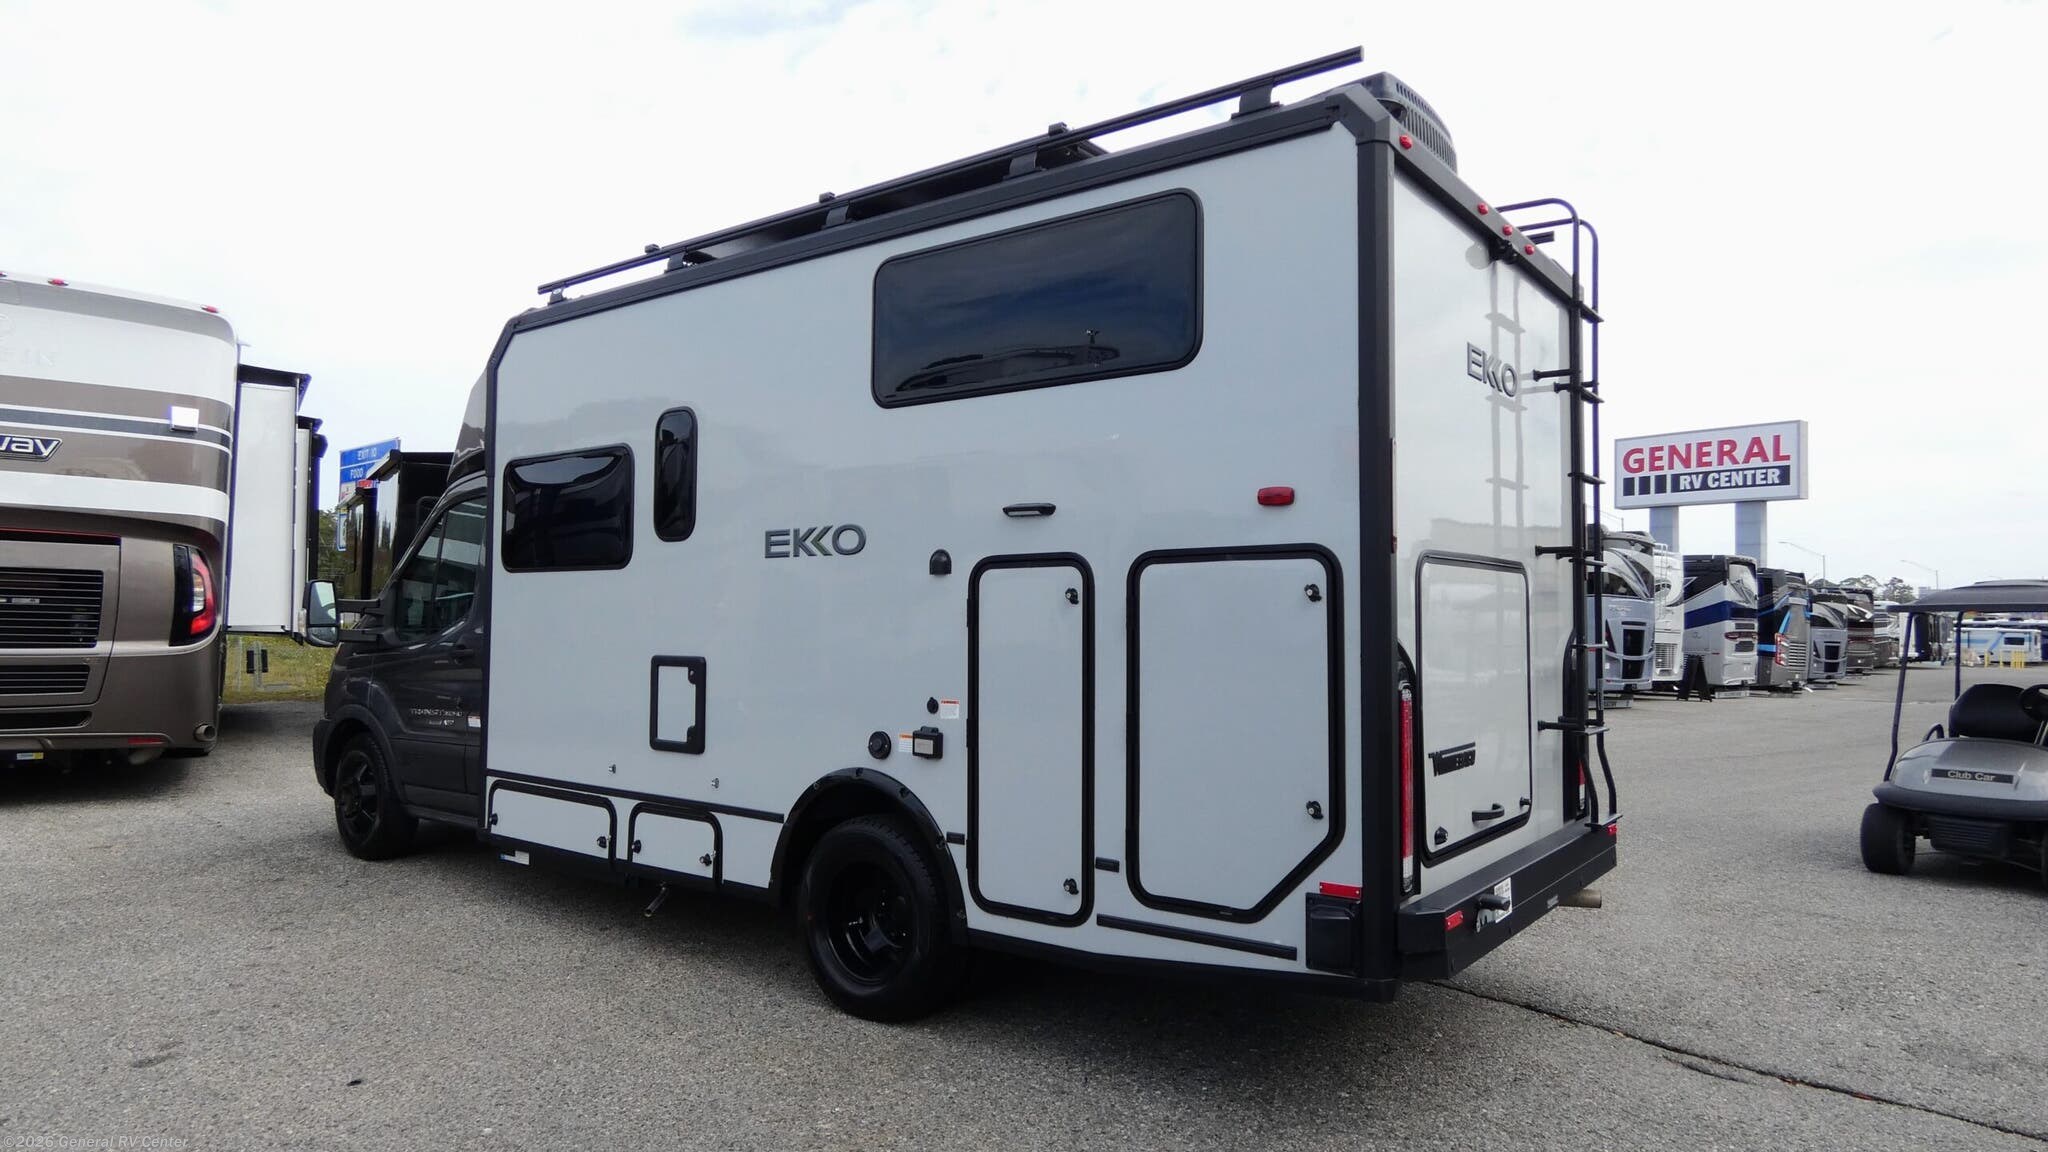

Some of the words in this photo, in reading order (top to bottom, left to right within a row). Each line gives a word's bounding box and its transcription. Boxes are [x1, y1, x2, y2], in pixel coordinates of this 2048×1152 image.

[1467, 342, 1518, 397] EKKO
[1623, 435, 1790, 474] GENERAL
[350, 468, 364, 479] FOOD
[1679, 474, 1706, 490] RV
[1707, 468, 1780, 488] CENTER
[765, 524, 867, 558] EKKO
[1947, 770, 1972, 780] Club
[1974, 772, 1996, 781] Car
